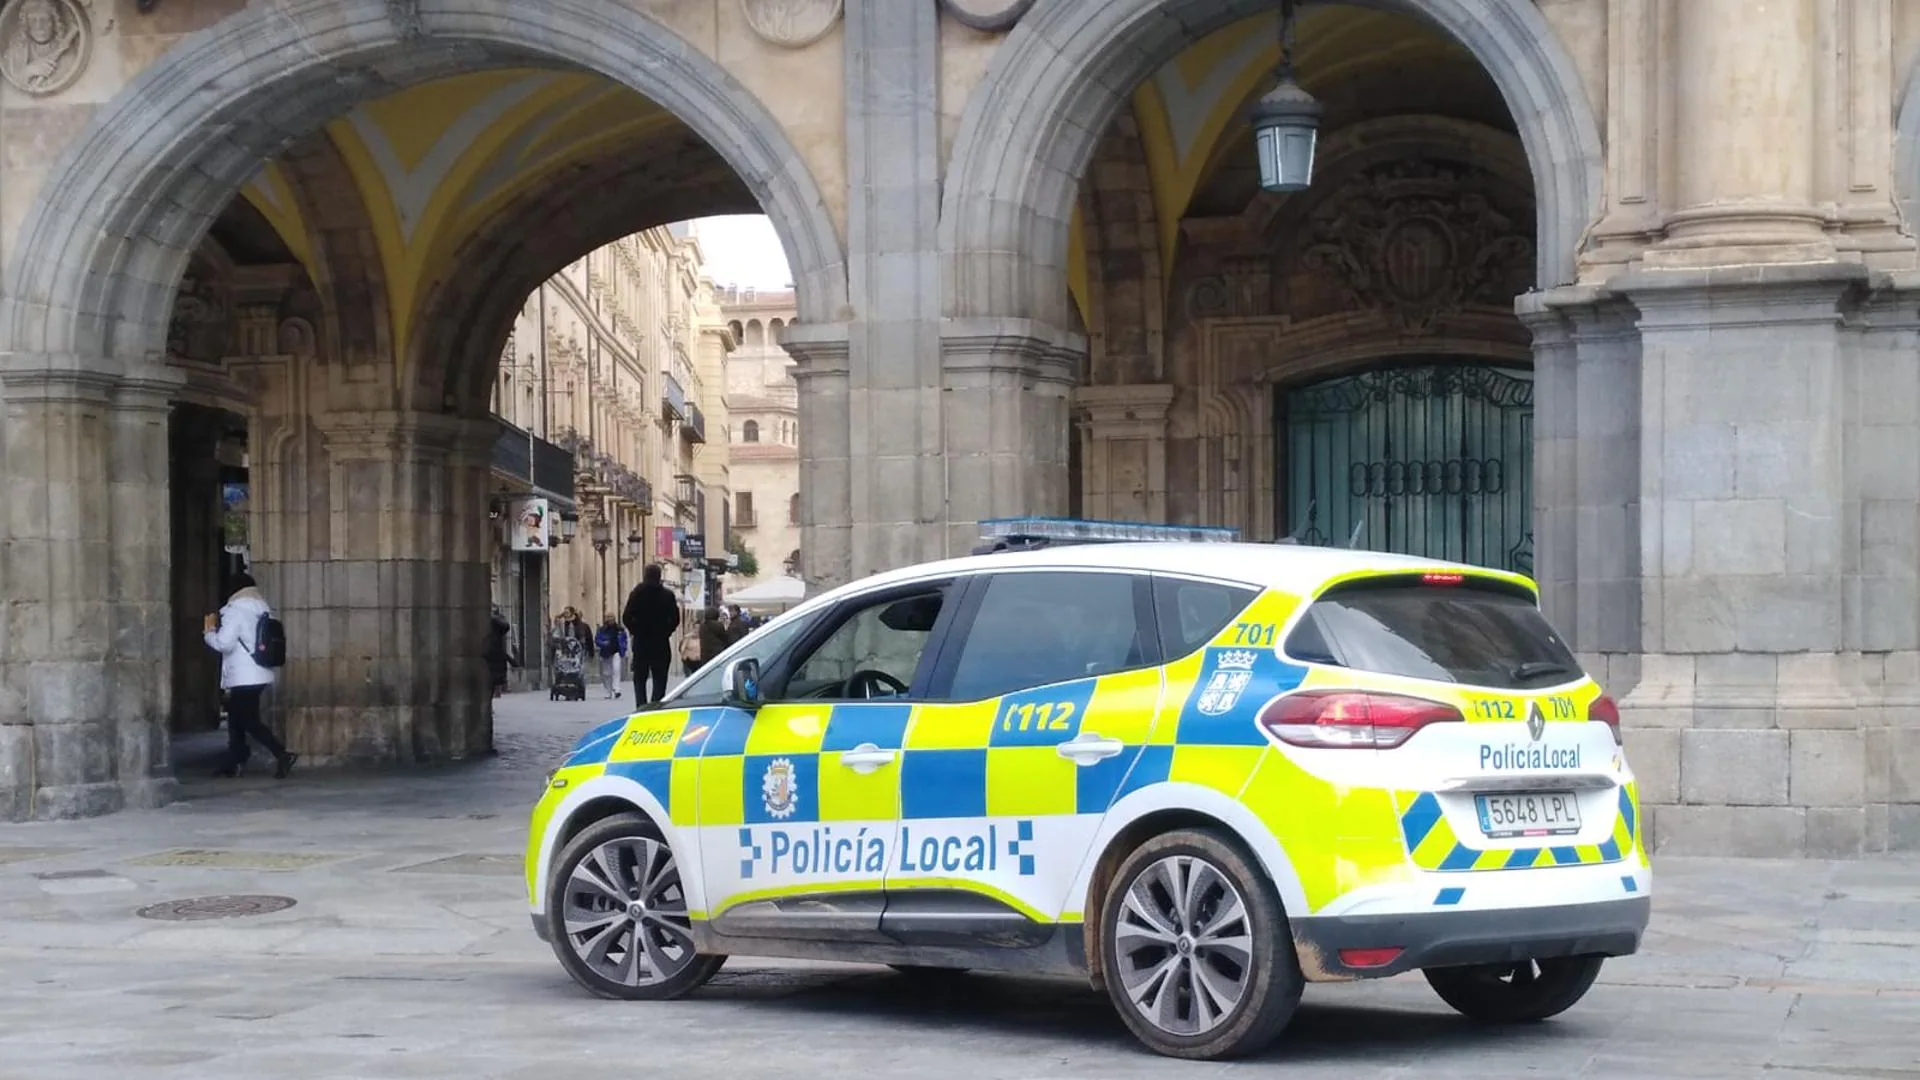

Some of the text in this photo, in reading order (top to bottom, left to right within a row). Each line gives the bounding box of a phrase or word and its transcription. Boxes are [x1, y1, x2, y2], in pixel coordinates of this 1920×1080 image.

[1235, 623, 1276, 645] 701
[1018, 702, 1076, 730] 112
[1481, 696, 1576, 719] 112 701
[1543, 743, 1580, 768] Local
[1490, 797, 1576, 824] 5648 LPL
[771, 824, 996, 873] Policía Local
